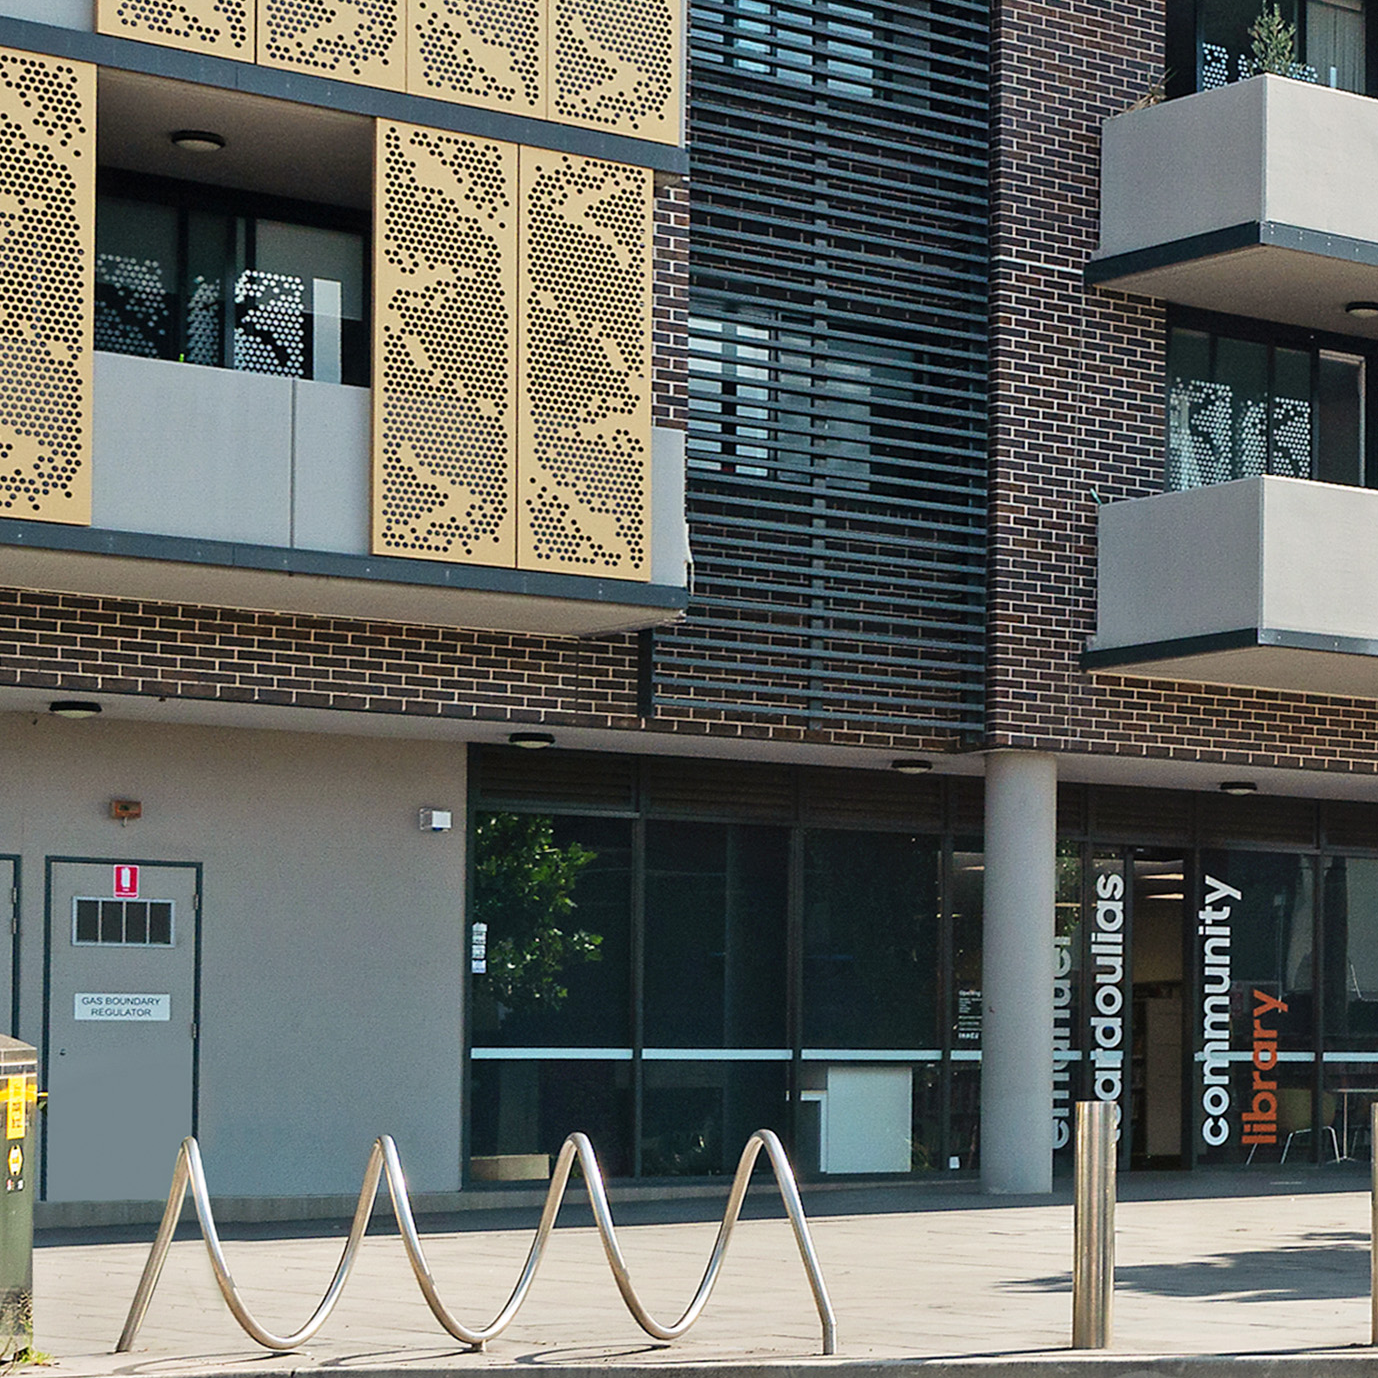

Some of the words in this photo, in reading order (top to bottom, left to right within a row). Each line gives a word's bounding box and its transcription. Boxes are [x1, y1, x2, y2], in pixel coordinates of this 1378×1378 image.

[81, 997, 103, 1005] GAS
[105, 997, 161, 1005] BOUNDARY
[91, 1008, 152, 1016] REGULATOR
[1091, 874, 1124, 1141] ardoulias
[1198, 874, 1242, 1146] community
[1241, 989, 1288, 1144] library
